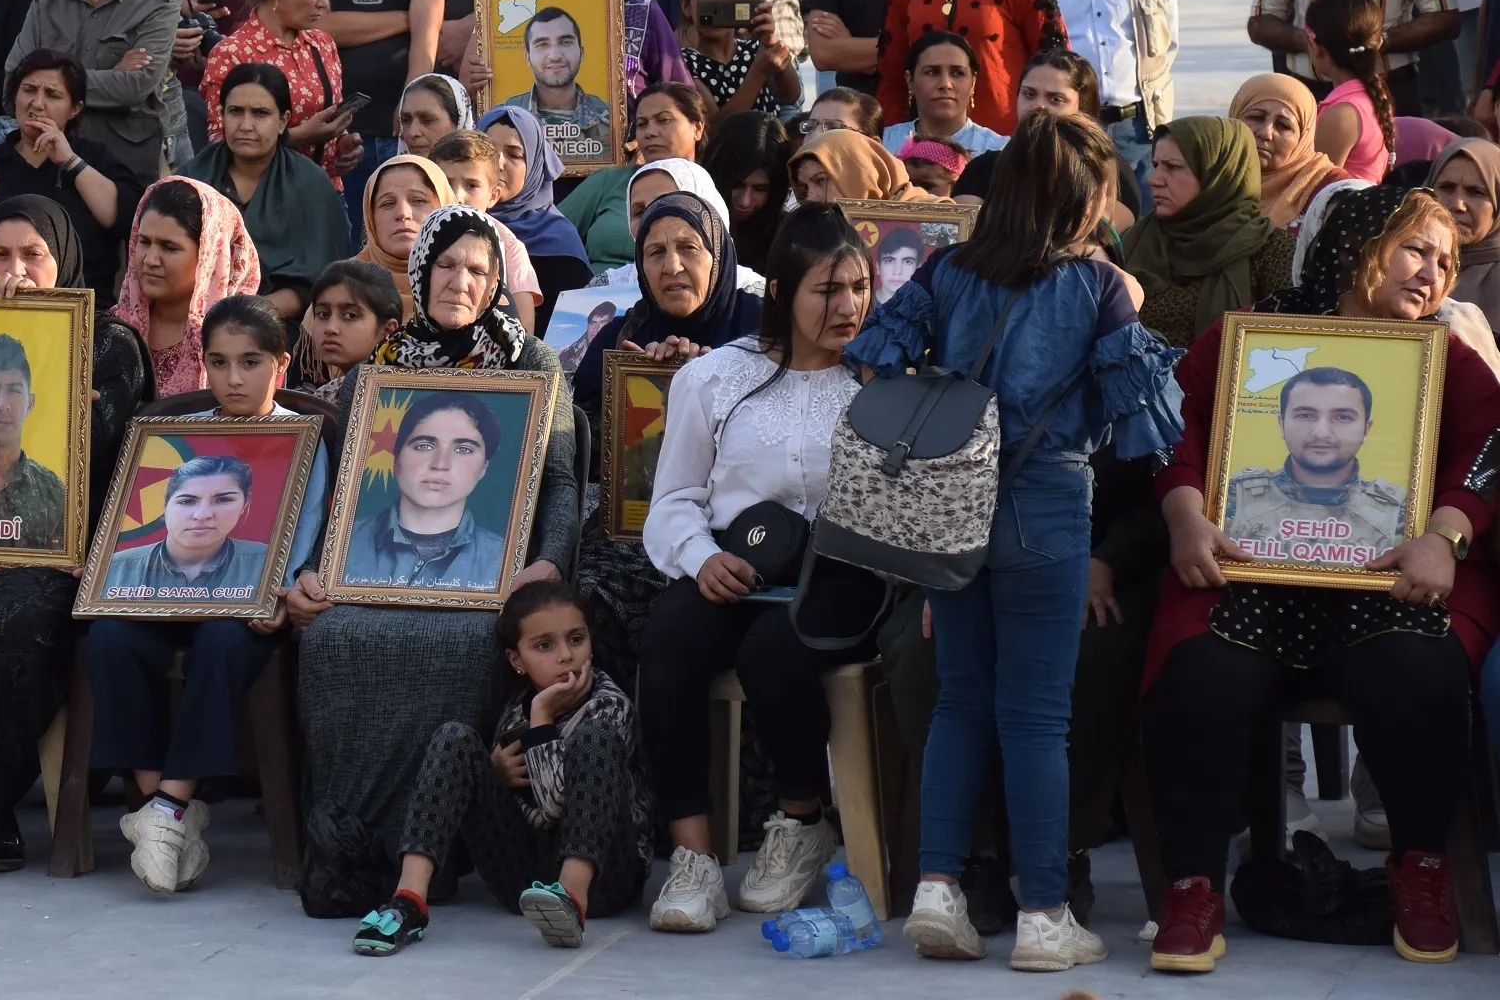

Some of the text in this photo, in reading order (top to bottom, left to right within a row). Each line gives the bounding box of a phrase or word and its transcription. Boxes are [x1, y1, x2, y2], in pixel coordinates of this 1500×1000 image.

[544, 121, 581, 139] EHÎD
[566, 137, 603, 156] EGÎD
[1280, 516, 1351, 539] ŞEHÎD
[1230, 537, 1394, 567] ELÎL QAMIŞL
[107, 585, 254, 600] ŞEHÎD SARYA CUDÎ
[468, 580, 497, 591] لشهيدة
